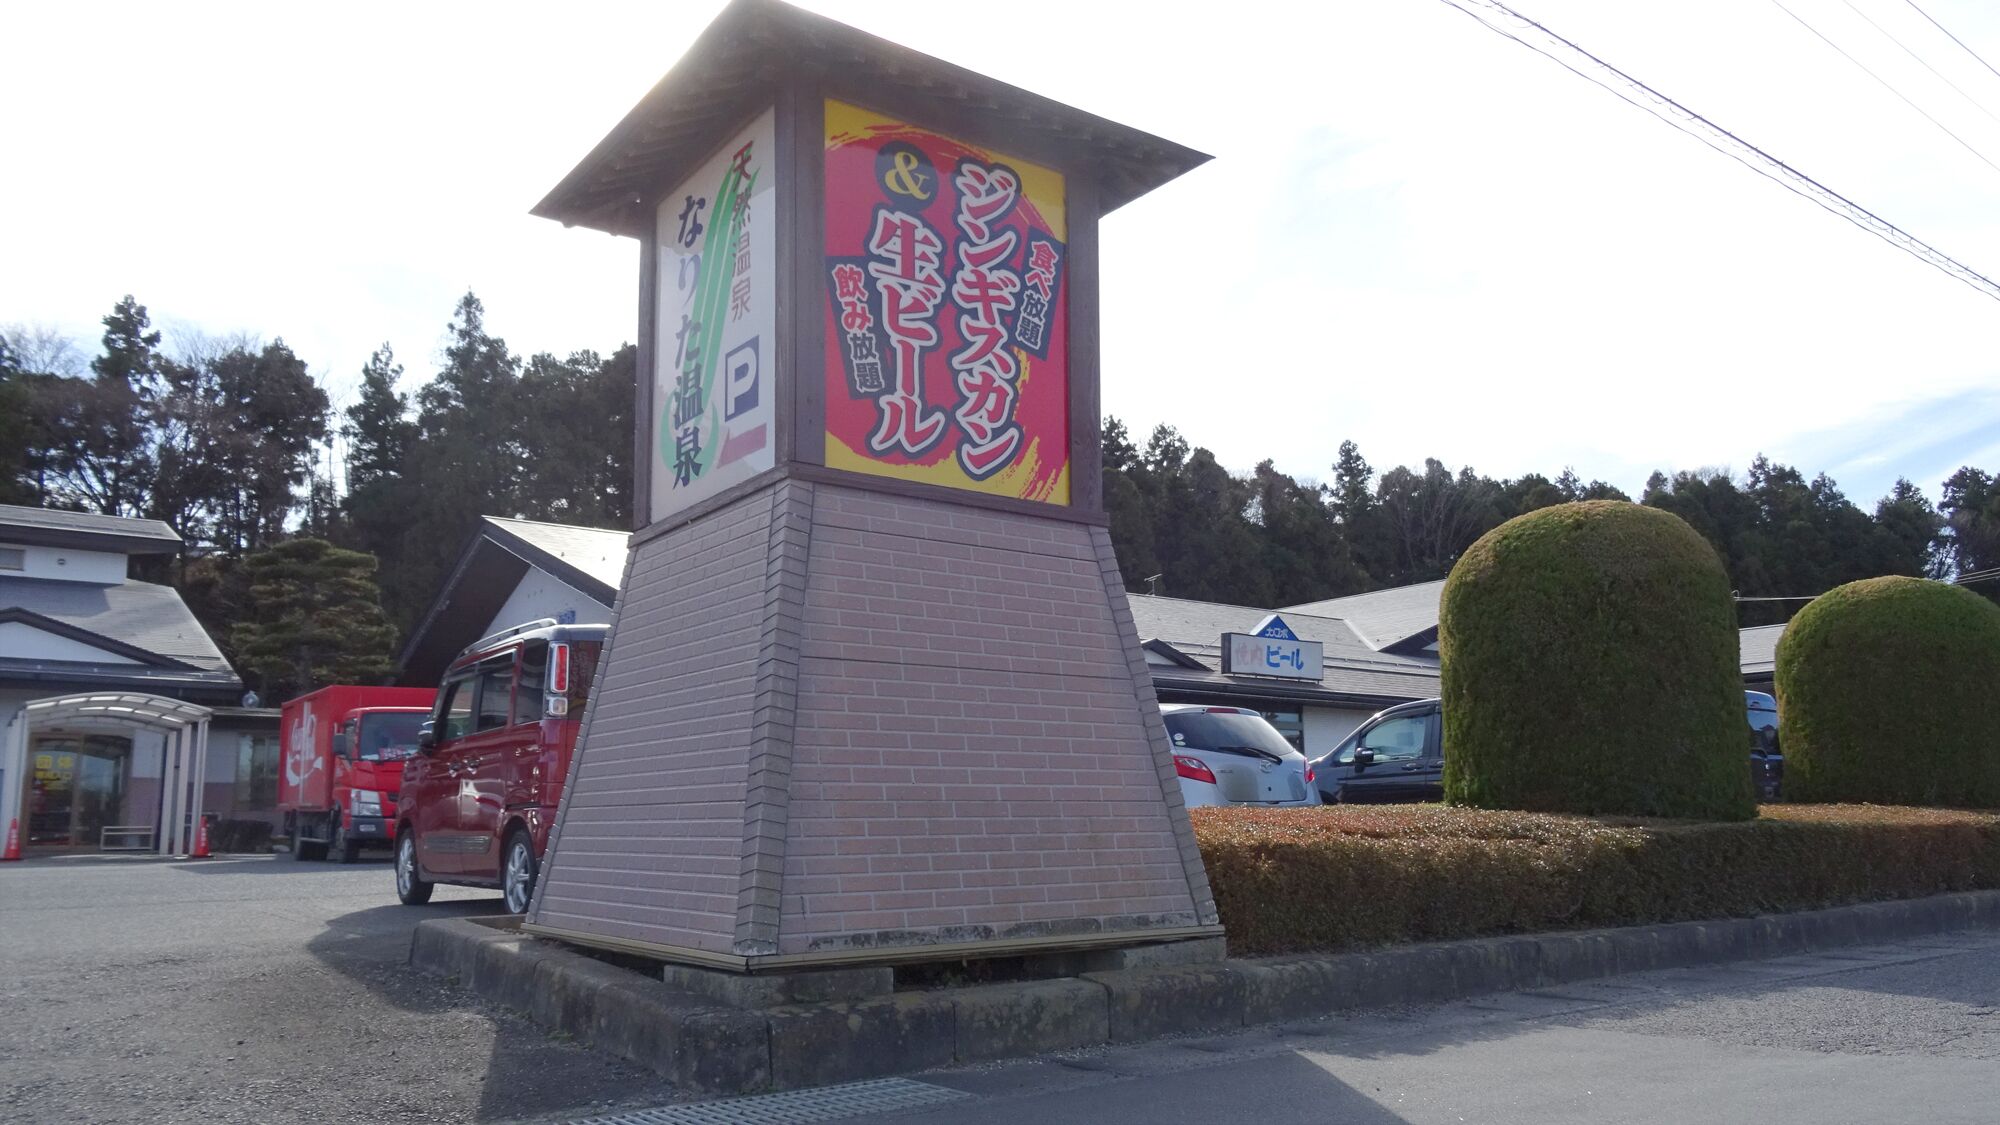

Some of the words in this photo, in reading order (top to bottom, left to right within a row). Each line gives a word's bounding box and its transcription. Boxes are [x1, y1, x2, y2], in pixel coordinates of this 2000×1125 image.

[731, 140, 755, 323] 天然温泉
[884, 150, 931, 201] &
[672, 195, 706, 490] なりた温泉
[831, 263, 883, 393] 飲み放題
[869, 209, 945, 453] 生ビール
[953, 162, 1019, 476] ジンギスカン
[1015, 240, 1059, 351] 食べ放題
[727, 342, 757, 417] P
